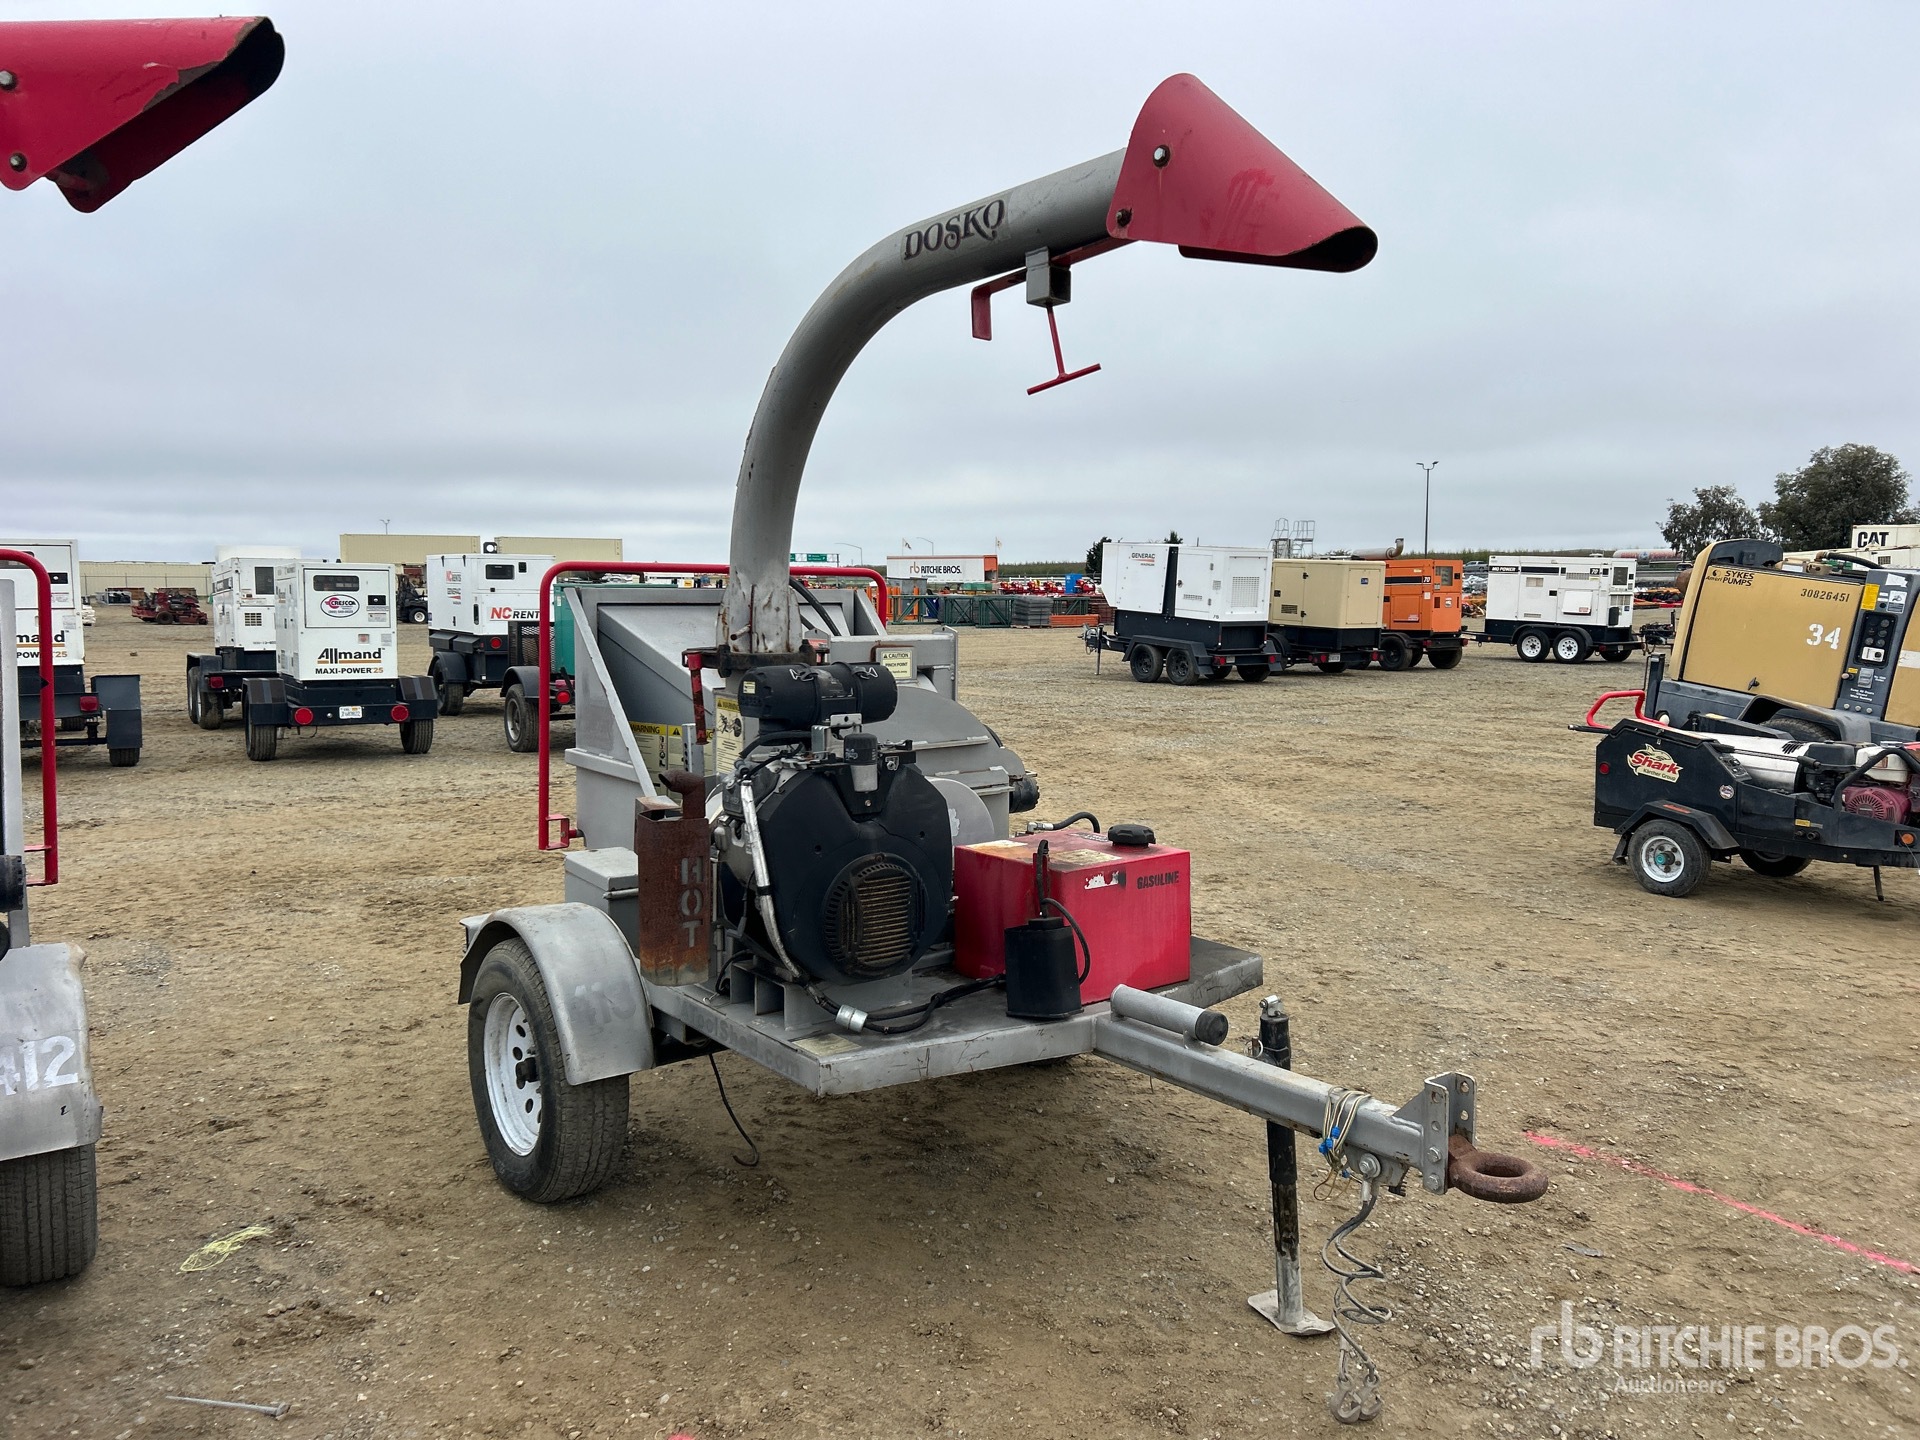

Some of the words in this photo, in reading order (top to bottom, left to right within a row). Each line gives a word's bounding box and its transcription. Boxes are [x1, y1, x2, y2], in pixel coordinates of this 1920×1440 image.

[904, 199, 1005, 260] DOSKO
[1857, 531, 1889, 548] CAT
[920, 565, 943, 574] RITCHIE
[943, 565, 962, 574] BROS.
[1725, 570, 1755, 580] SYKES
[1722, 577, 1753, 587] PUMPS
[1800, 588, 1850, 603] 30826451
[490, 607, 512, 619] NC
[512, 610, 540, 619] RENT
[1806, 623, 1841, 650] 34
[317, 648, 382, 664] Allmand
[631, 725, 660, 734] WARNING
[1632, 754, 1679, 775] Shark
[1137, 871, 1180, 890] GASOLINE
[681, 857, 704, 948] HOT
